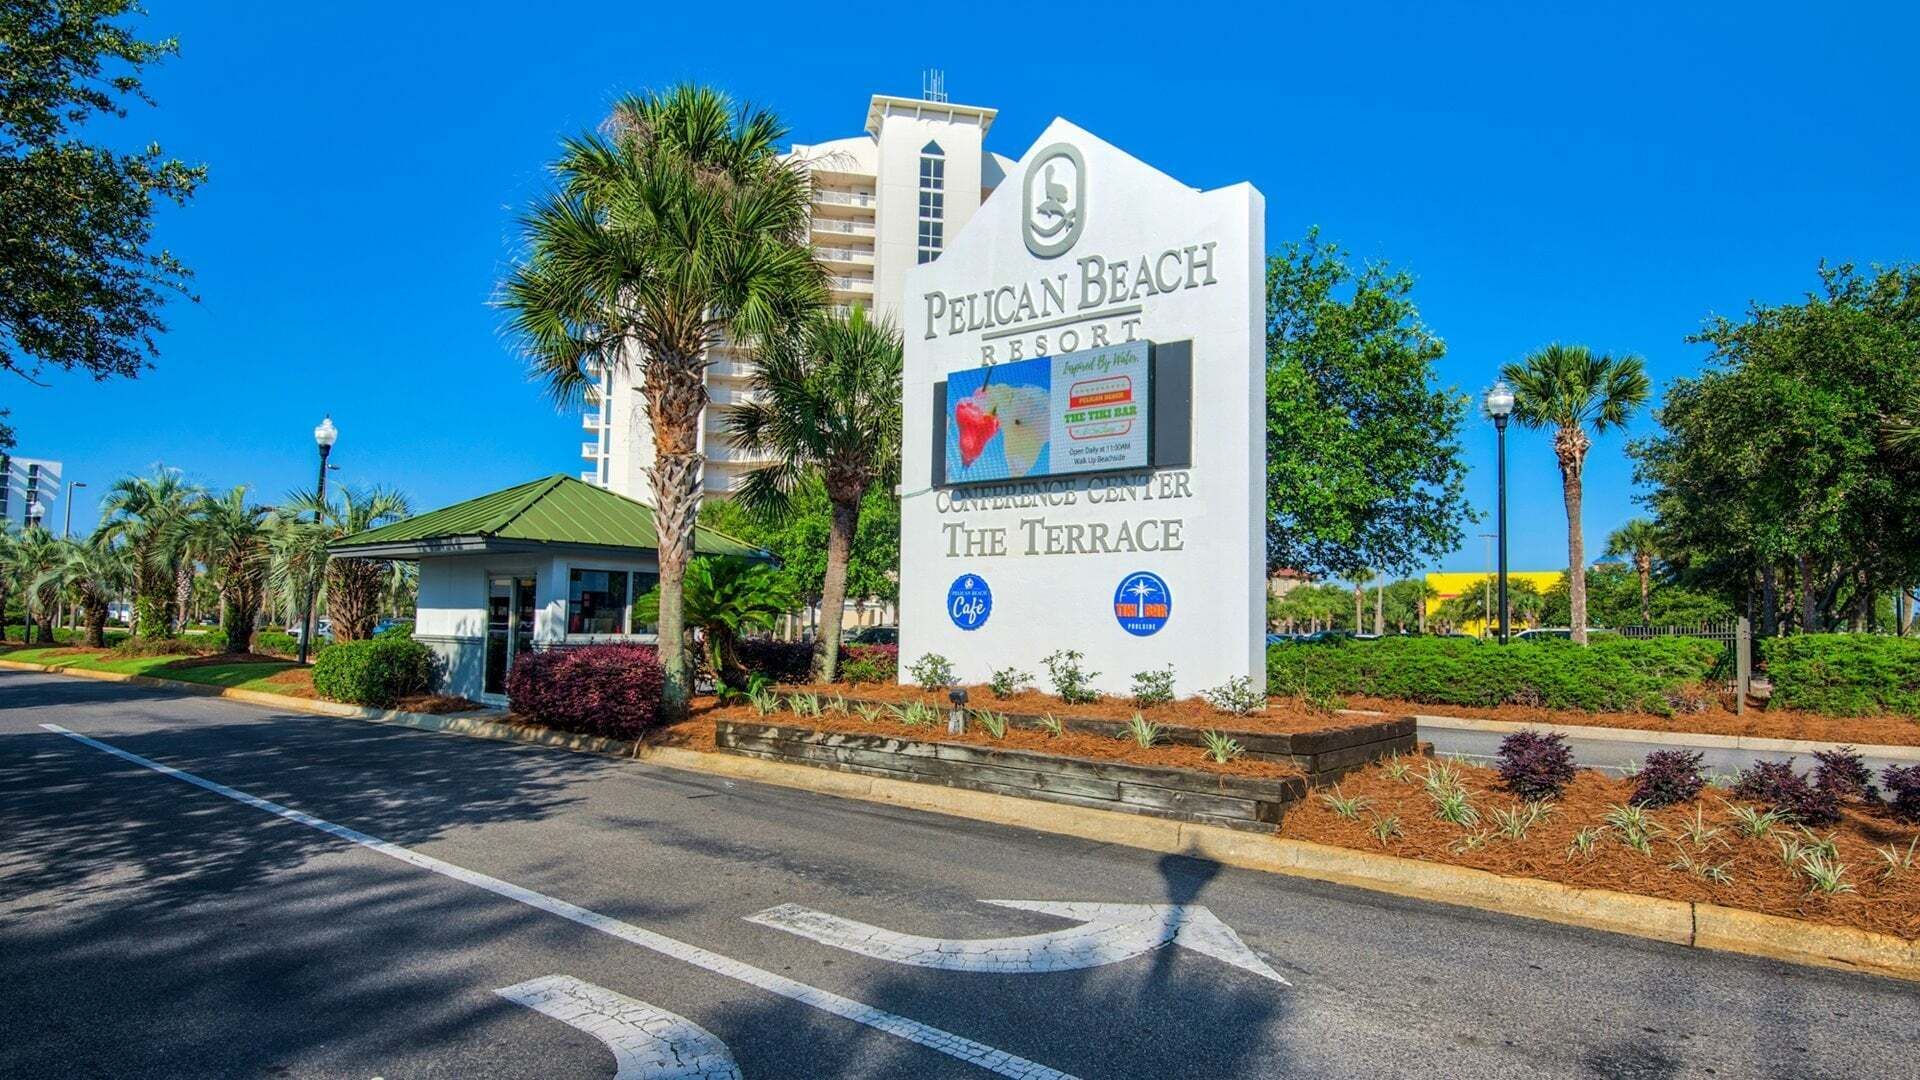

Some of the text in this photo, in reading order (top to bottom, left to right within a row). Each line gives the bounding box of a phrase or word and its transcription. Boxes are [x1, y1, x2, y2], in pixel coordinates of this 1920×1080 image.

[924, 241, 1217, 340] PELICAN BEACH
[981, 318, 1142, 367] RESORT
[1064, 405, 1137, 423] THE TIKI BAR
[1069, 447, 1085, 456] Open
[1085, 445, 1099, 455] Daily
[936, 471, 1193, 514] CONFERENCE CENTER
[942, 516, 1185, 558] THE TERRACE
[1115, 603, 1168, 618] TIKI BAR
